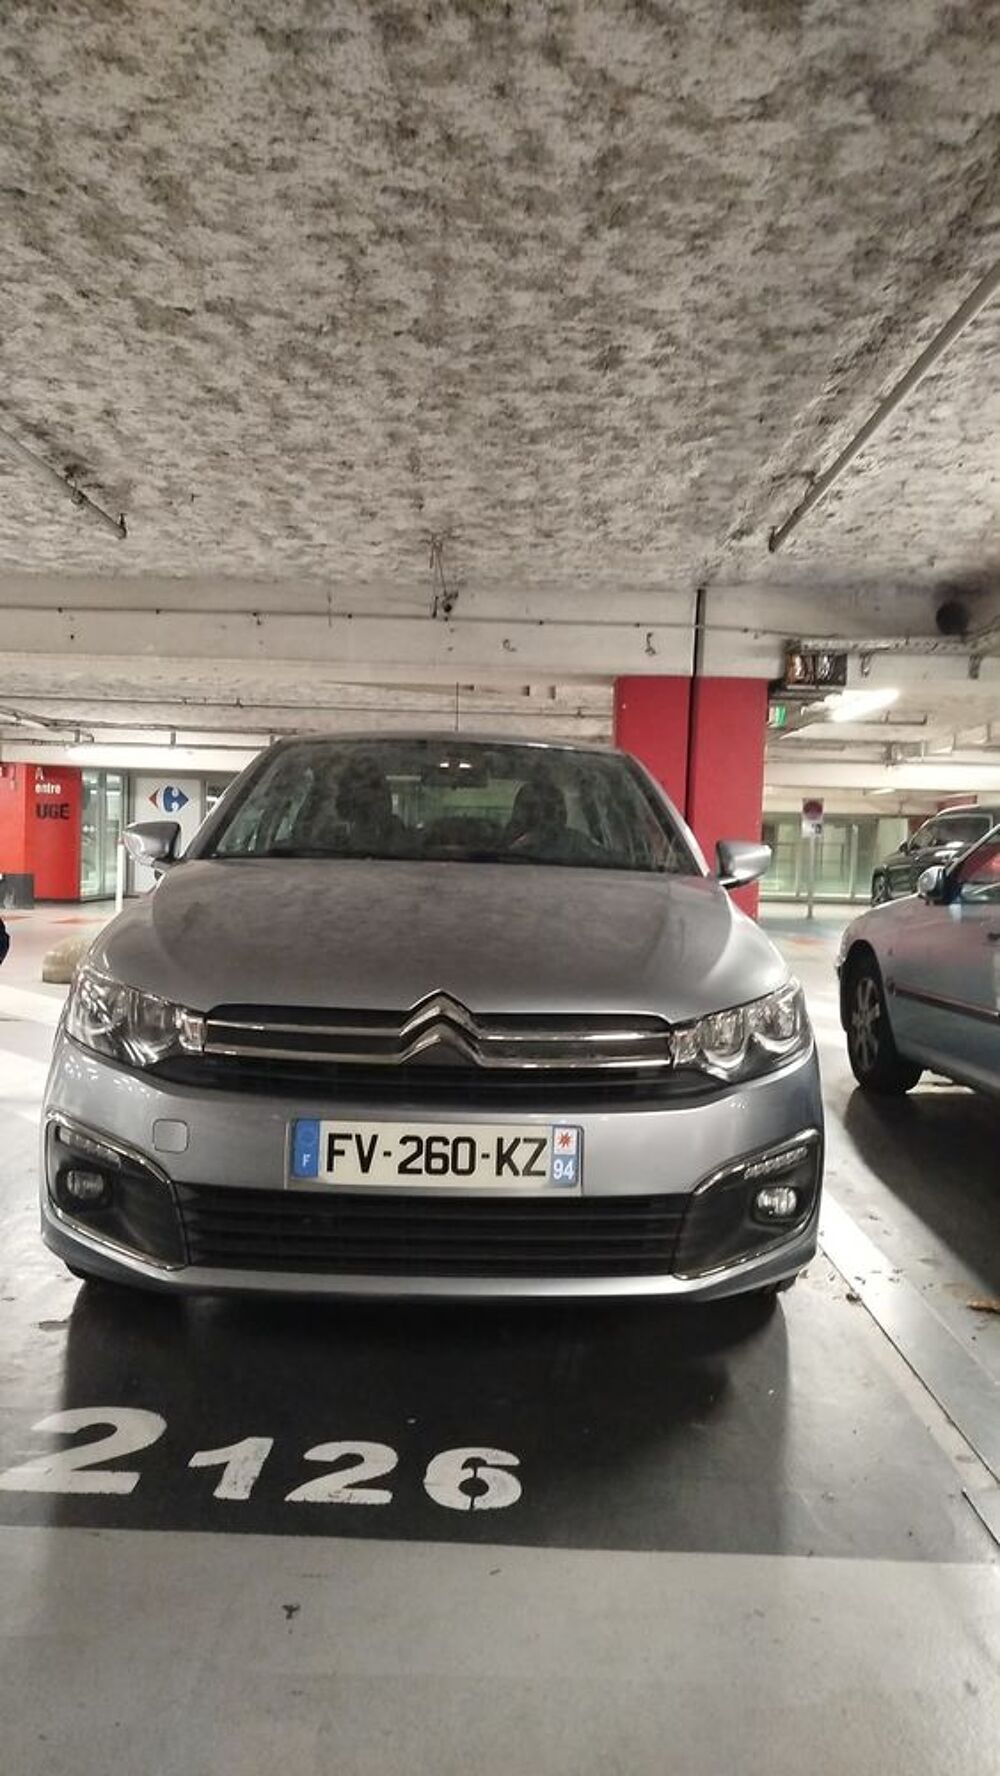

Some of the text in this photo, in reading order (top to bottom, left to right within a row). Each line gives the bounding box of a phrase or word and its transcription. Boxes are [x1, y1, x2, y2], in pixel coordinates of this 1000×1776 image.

[303, 1153, 311, 1167] F
[326, 1132, 548, 1177] FV-260-KZ
[553, 1159, 575, 1180] 94
[0, 1406, 523, 1510] 2126
